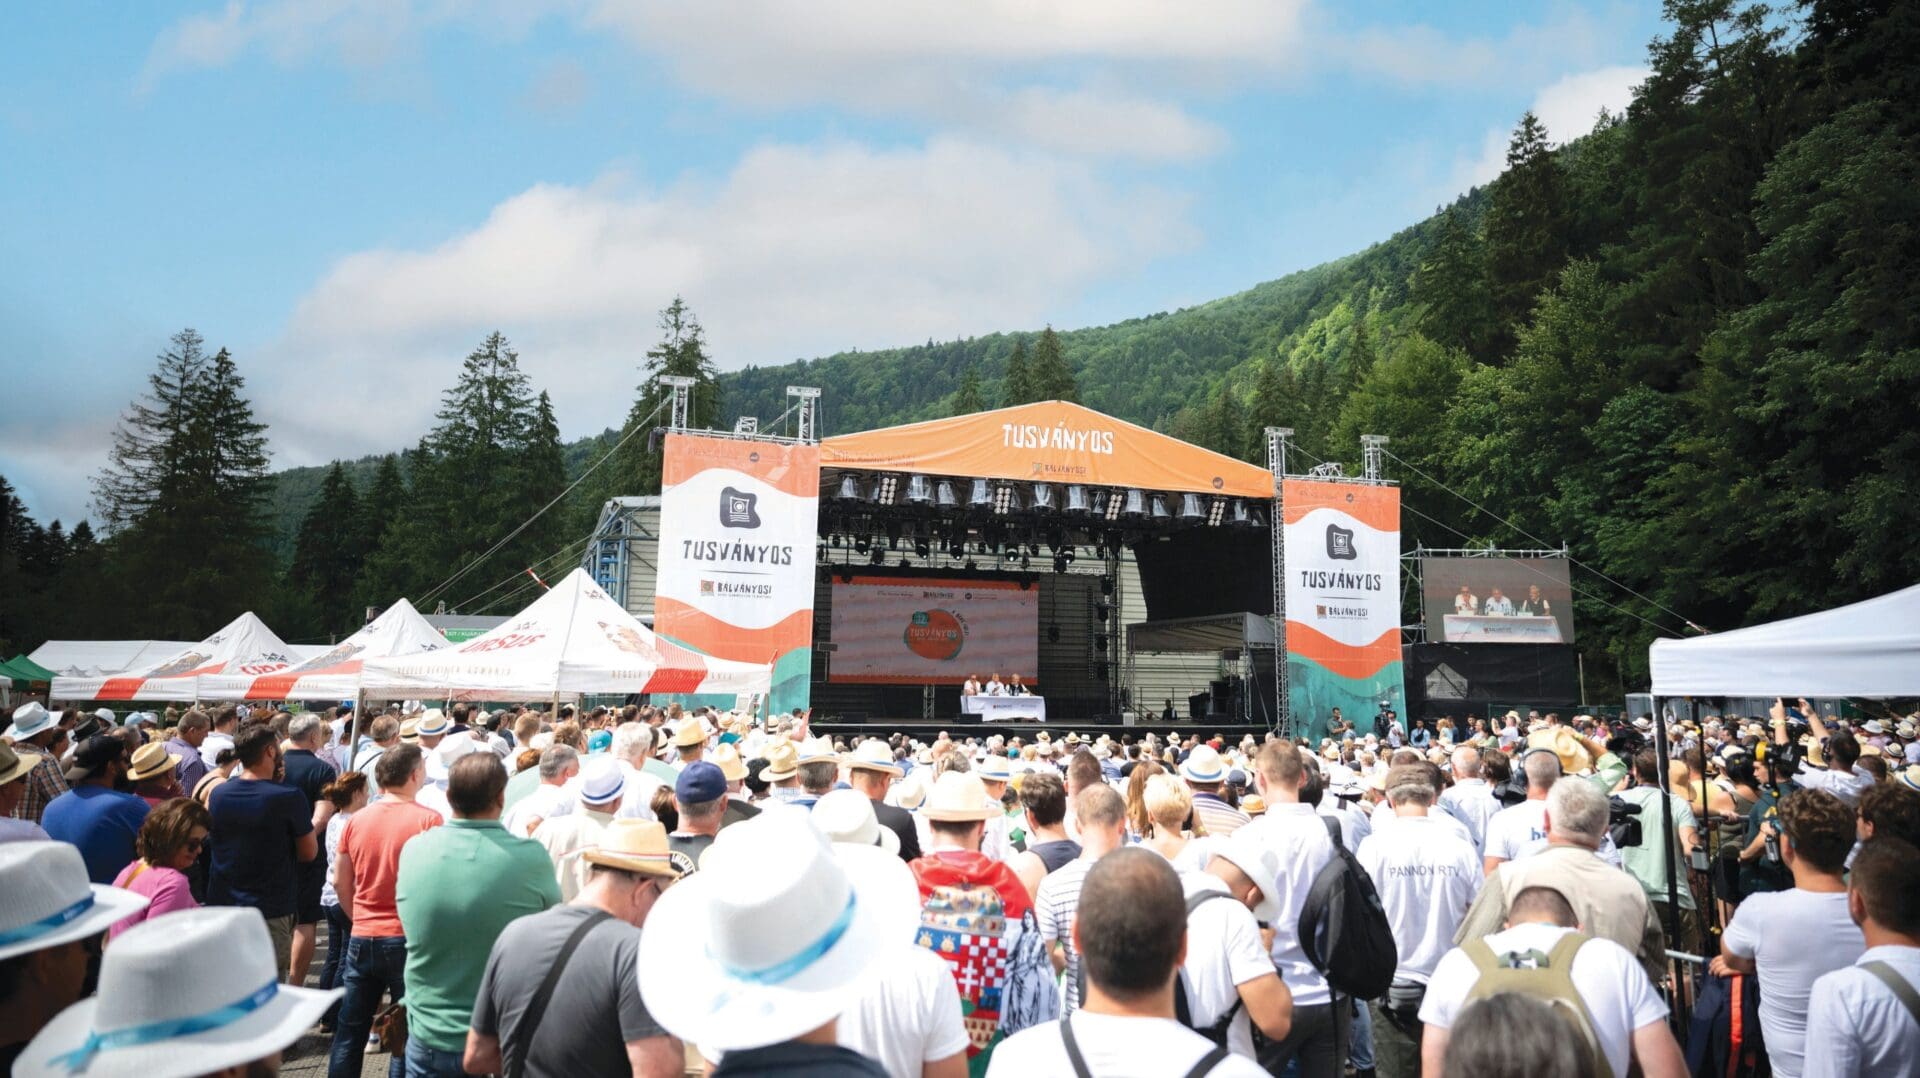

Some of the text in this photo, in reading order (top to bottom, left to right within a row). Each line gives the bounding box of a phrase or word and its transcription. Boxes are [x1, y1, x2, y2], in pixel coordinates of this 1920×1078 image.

[1002, 421, 1115, 455] TUSVÁNYOS
[683, 538, 793, 566] TUSVÁNYOS
[1301, 568, 1382, 591] TUSVÁNYOS
[459, 633, 546, 654] URSUS
[1438, 863, 1460, 878] RTV
